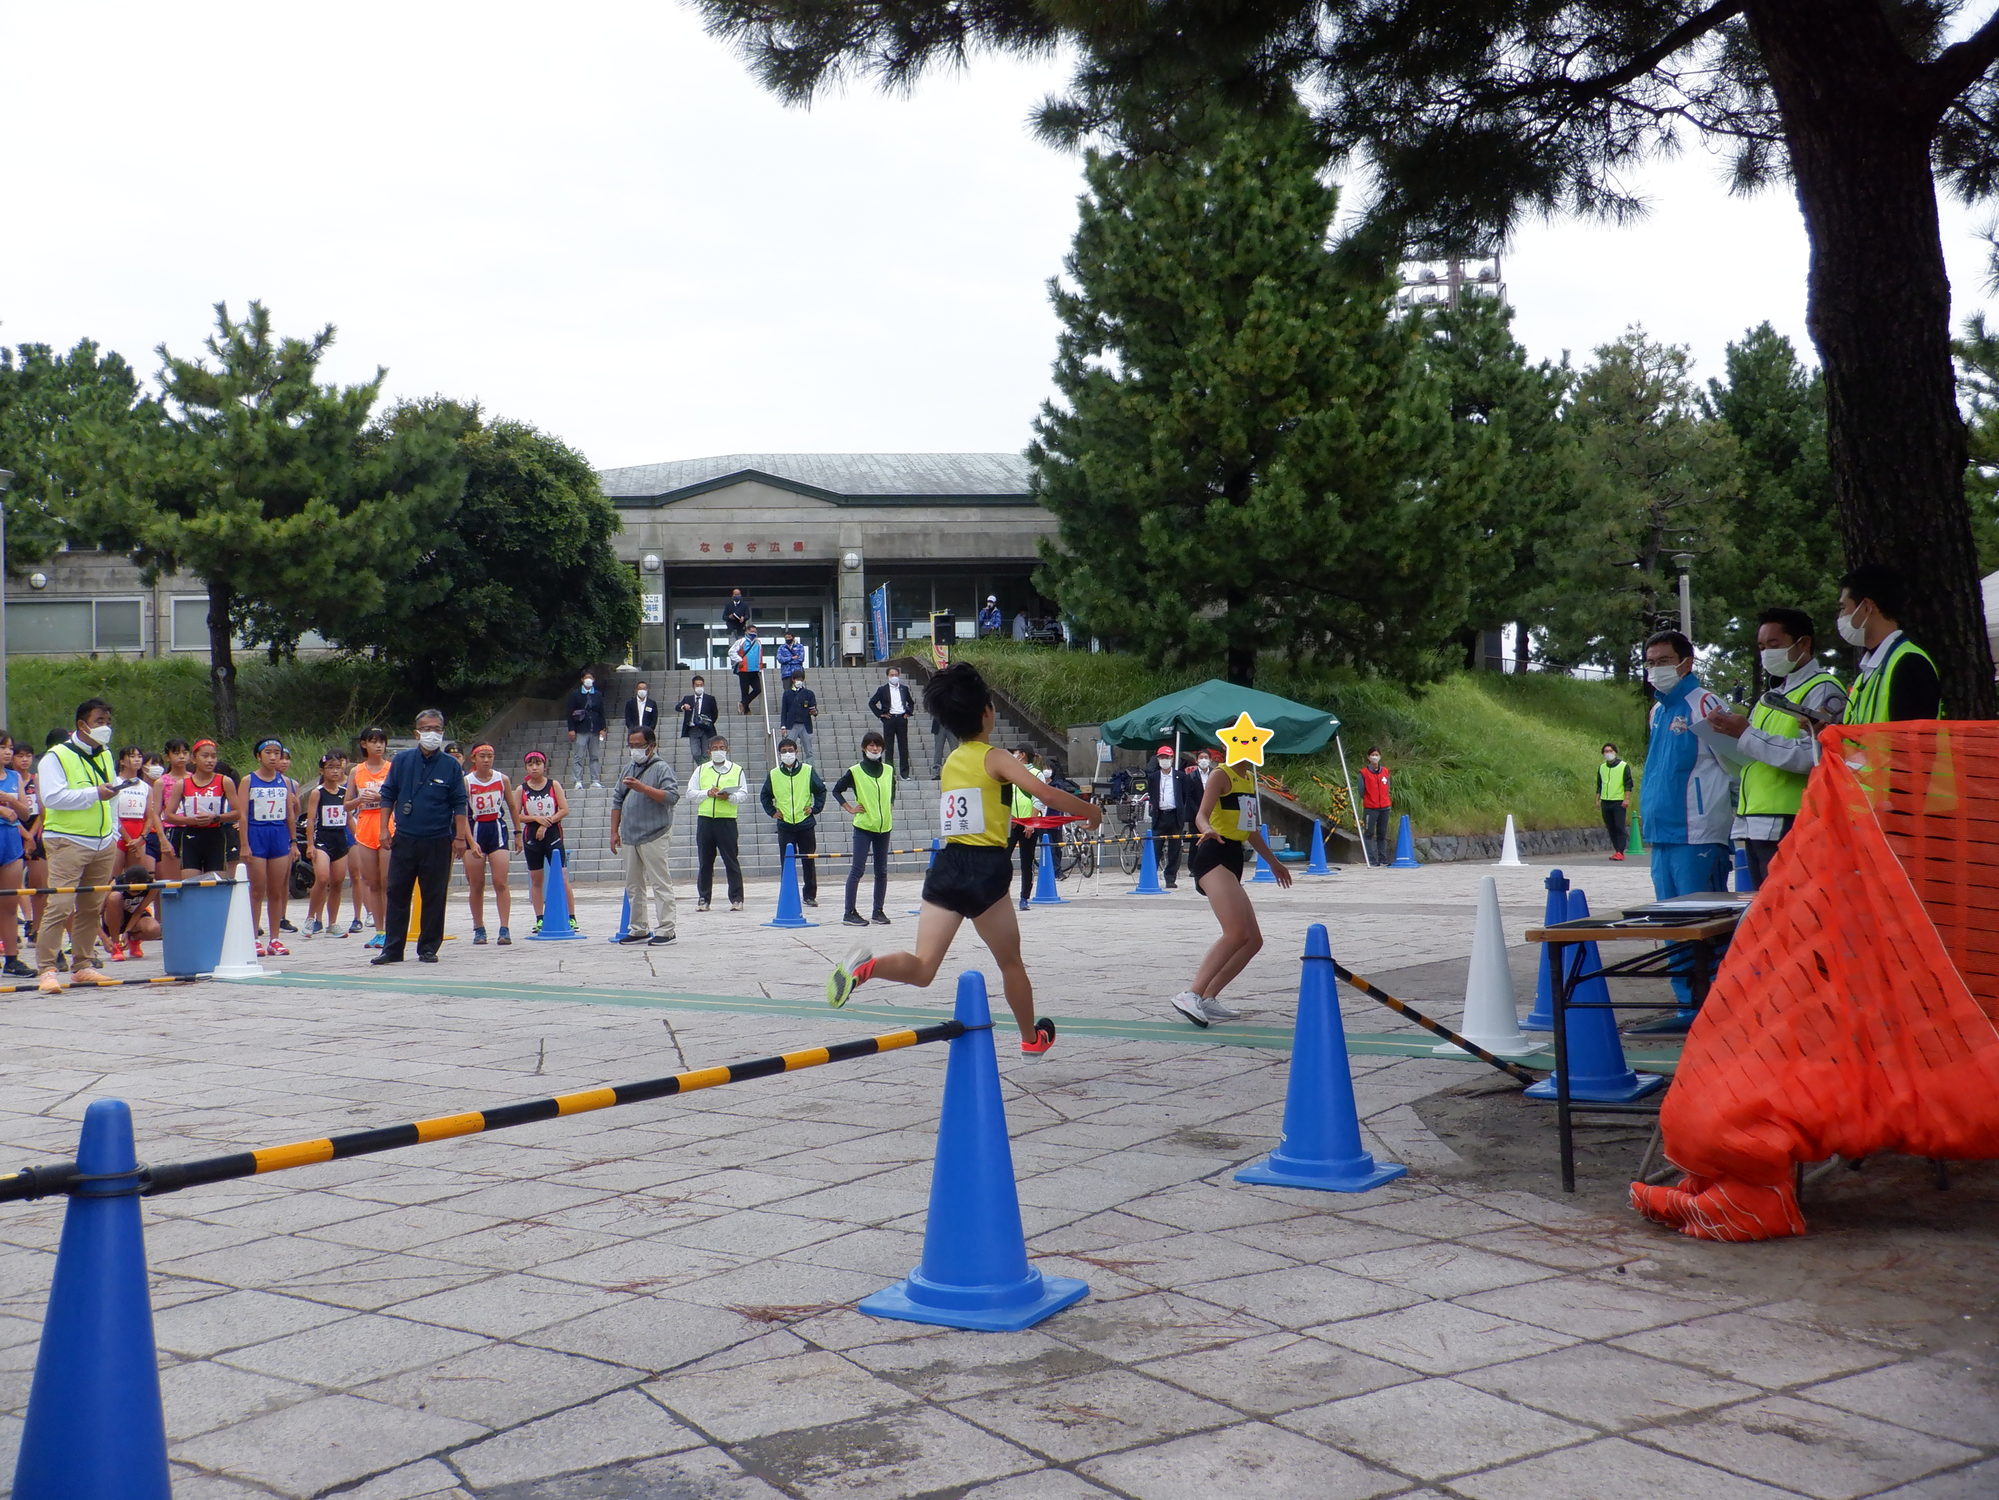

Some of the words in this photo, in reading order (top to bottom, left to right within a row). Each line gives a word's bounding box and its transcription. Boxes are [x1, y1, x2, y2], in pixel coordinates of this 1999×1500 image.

[256, 788, 285, 799] 釜利谷
[127, 799, 138, 808] 32
[266, 800, 277, 814] 7
[475, 793, 495, 811] 81
[536, 801, 544, 811] 9
[945, 794, 968, 819] 33
[326, 807, 340, 819] 15
